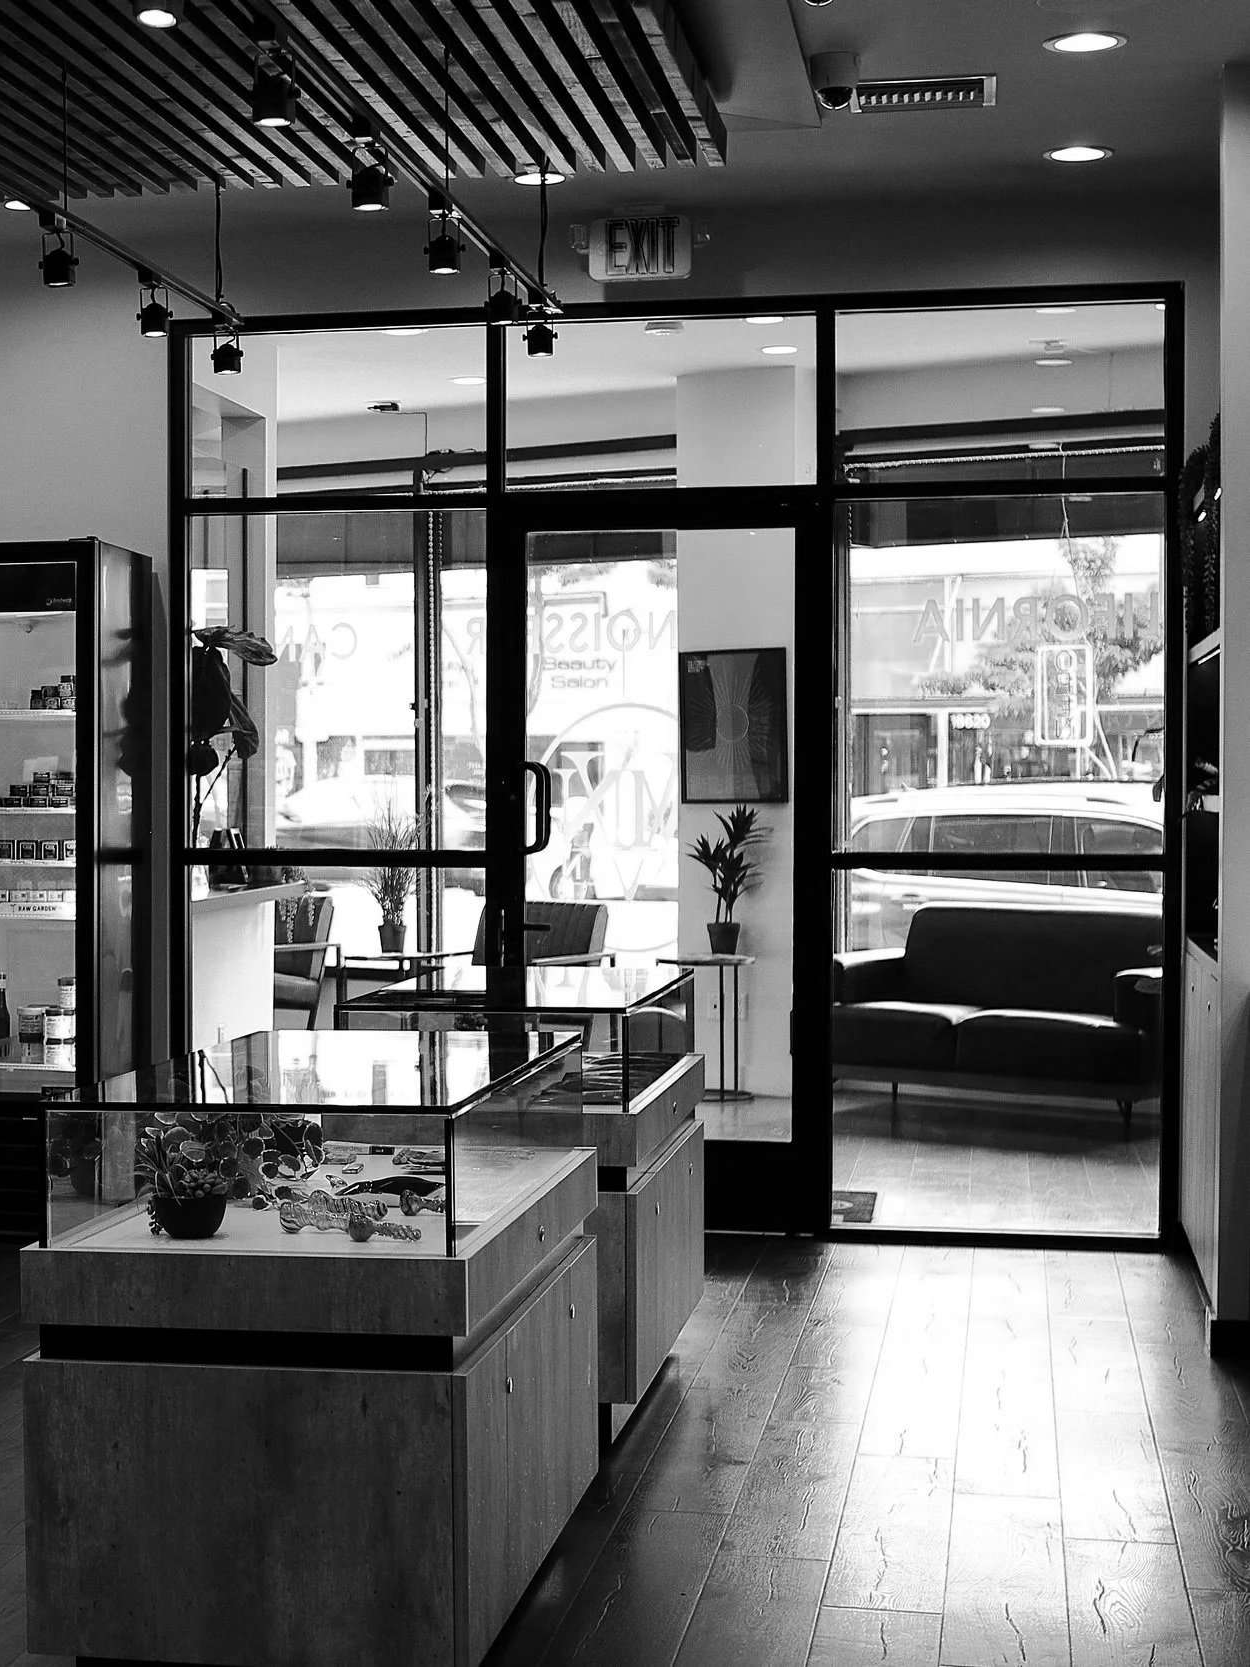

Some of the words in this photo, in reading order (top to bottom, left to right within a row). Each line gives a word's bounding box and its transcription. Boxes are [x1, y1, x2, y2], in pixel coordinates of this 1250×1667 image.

[606, 216, 680, 275] EXIT
[541, 656, 617, 673] Beauty
[551, 675, 609, 689] Salon
